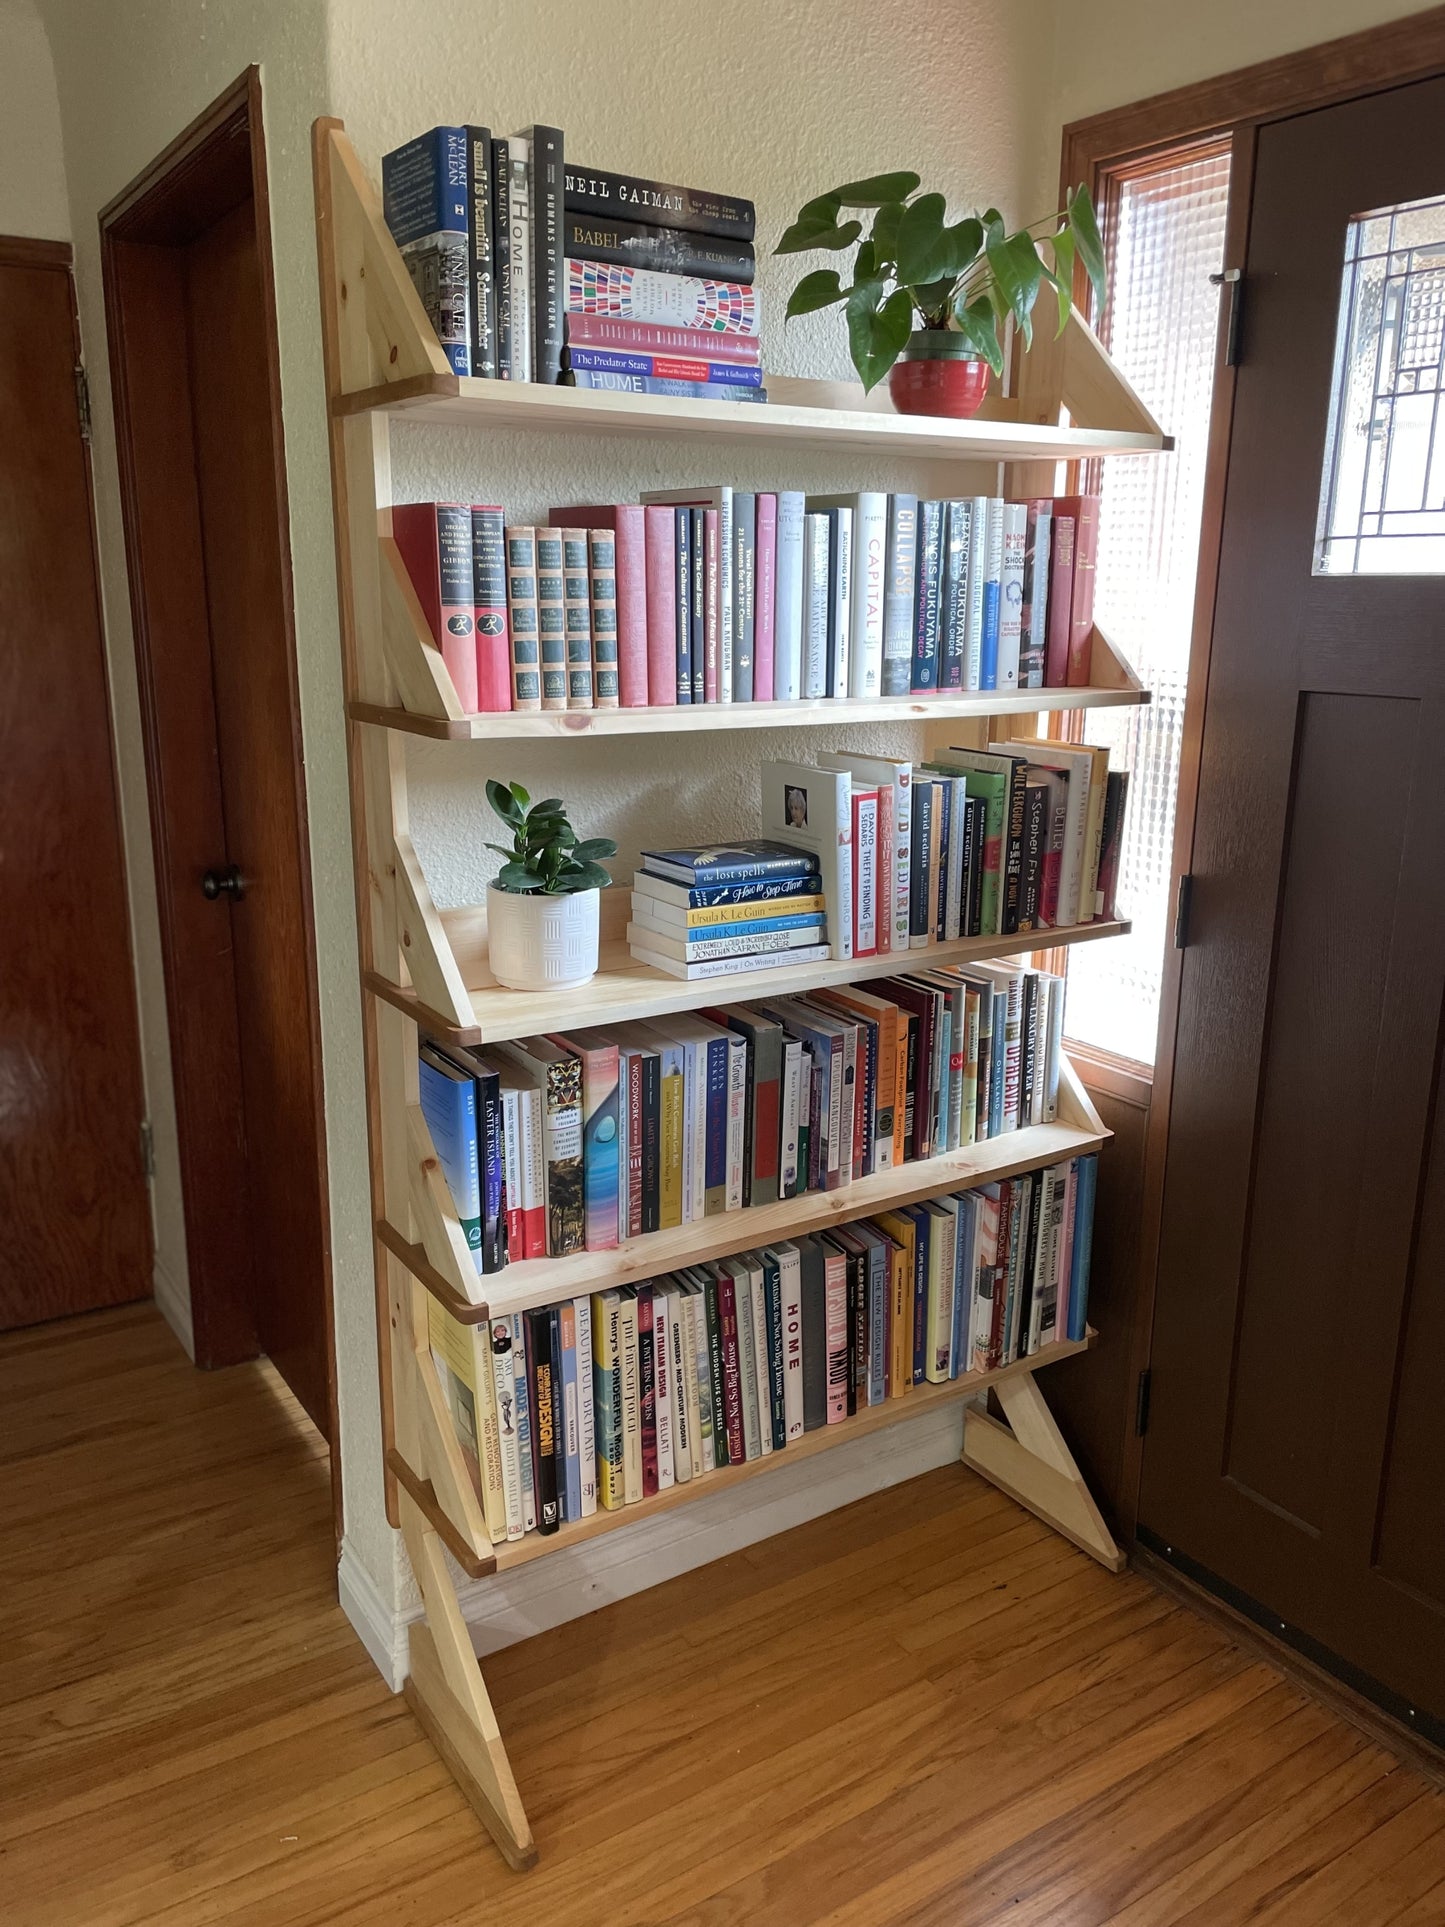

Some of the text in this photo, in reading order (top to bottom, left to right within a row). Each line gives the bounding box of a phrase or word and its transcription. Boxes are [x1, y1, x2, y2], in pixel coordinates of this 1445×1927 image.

[458, 138, 467, 189] STUART
[565, 176, 682, 212] NEIL GAIMAN
[473, 141, 491, 349] small is beautiful Schumacher
[511, 199, 528, 275] HOME
[573, 227, 623, 249] BABEL
[451, 245, 464, 289] VINYL
[546, 194, 556, 329] HUMANS OF NEW YORK
[575, 354, 592, 364] The
[594, 356, 626, 367] Predator
[629, 361, 647, 370] State
[591, 372, 642, 392] HUME
[896, 510, 914, 595] COLLAPSE
[867, 539, 880, 628] CAPITAL
[925, 512, 940, 658] FRANCIS FUKUYAMA
[955, 512, 970, 656] FRANCIS FUKUYAMA
[709, 608, 716, 617] of
[737, 609, 745, 639] Century
[708, 640, 716, 668] Poverty
[1014, 765, 1026, 787] WILL
[1011, 791, 1024, 837] FERGUSON
[896, 774, 909, 931] DAVID SEDARIS
[921, 833, 929, 868] sedaris
[1027, 803, 1041, 880] Stephen Fry
[716, 868, 734, 879] lost
[738, 866, 765, 879] spells
[842, 849, 850, 879] ALICE
[863, 849, 871, 876] THEFT
[733, 887, 755, 903] How
[762, 885, 781, 900] Stop
[692, 913, 719, 925] Ursula
[732, 910, 742, 920] Le
[744, 908, 765, 918] Guin
[694, 940, 789, 958] JONATHAN SAFRAN FOER
[700, 964, 722, 974] Stephen
[724, 963, 738, 972] King
[755, 959, 775, 967] Writing
[1007, 980, 1017, 1016] DIAMOND
[1025, 1007, 1037, 1090] LUXURY FEVER
[731, 1053, 744, 1117] The Growth Illusion
[1005, 1047, 1020, 1116] UPHEAVAL
[831, 1054, 840, 1149] EXPLORING VANCOUVER
[486, 1100, 495, 1175] EASTER ISLAND
[997, 1201, 1008, 1259] FARMHOUSE
[828, 1261, 846, 1283] THE
[772, 1273, 780, 1310] Outside
[827, 1288, 845, 1331] UPSIDE
[610, 1312, 620, 1352] Henry's
[673, 1323, 681, 1364] GREENBERG
[775, 1340, 781, 1350] So
[787, 1304, 799, 1369] HOME
[828, 1335, 845, 1347] OF
[504, 1358, 513, 1376] ART
[658, 1337, 666, 1368] ITALIAN
[773, 1350, 782, 1367] Big
[495, 1360, 505, 1389] DECO
[580, 1309, 594, 1462] BEAUTIFUL BRITAIN
[612, 1357, 621, 1430] WONDERFUL
[623, 1317, 636, 1432] THE FRENCH TOUCH
[658, 1371, 667, 1397] DESIGN
[775, 1367, 783, 1396] House
[644, 1385, 653, 1420] GARDEN
[676, 1369, 687, 1448] MID-CENTURY MODERN
[716, 1398, 721, 1407] OF
[515, 1376, 532, 1491] MADE YOU LAUGH!
[539, 1400, 553, 1446] DESIGN
[660, 1417, 669, 1454] BELLATI
[485, 1437, 495, 1491] RESTORATIONS
[489, 1413, 502, 1491] GREAT RENOVATIONS
[614, 1435, 623, 1466] Model
[503, 1439, 518, 1518] JUDITH MILLER
